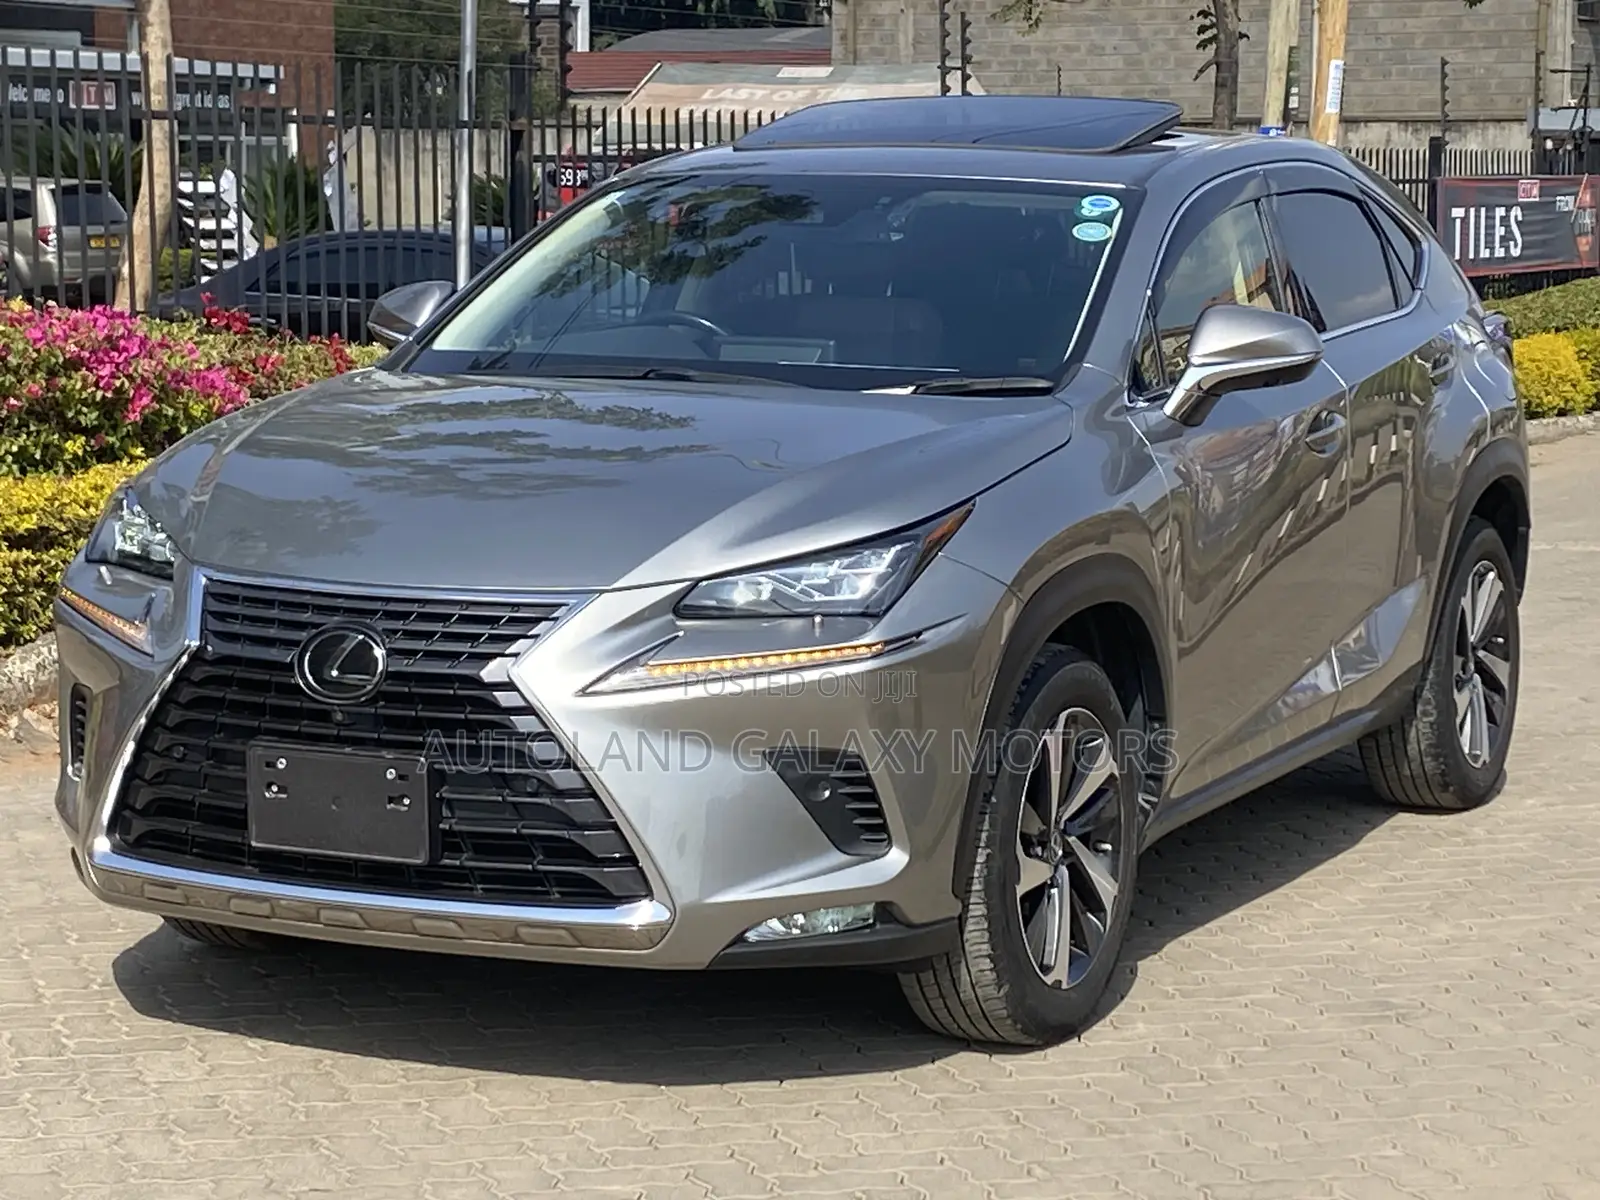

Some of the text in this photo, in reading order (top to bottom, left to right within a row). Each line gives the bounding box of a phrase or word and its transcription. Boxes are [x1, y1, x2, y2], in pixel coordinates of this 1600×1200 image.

[5, 83, 51, 103] elcme
[699, 88, 770, 100] LAST
[771, 89, 809, 101] OF
[1451, 205, 1523, 260] TILES
